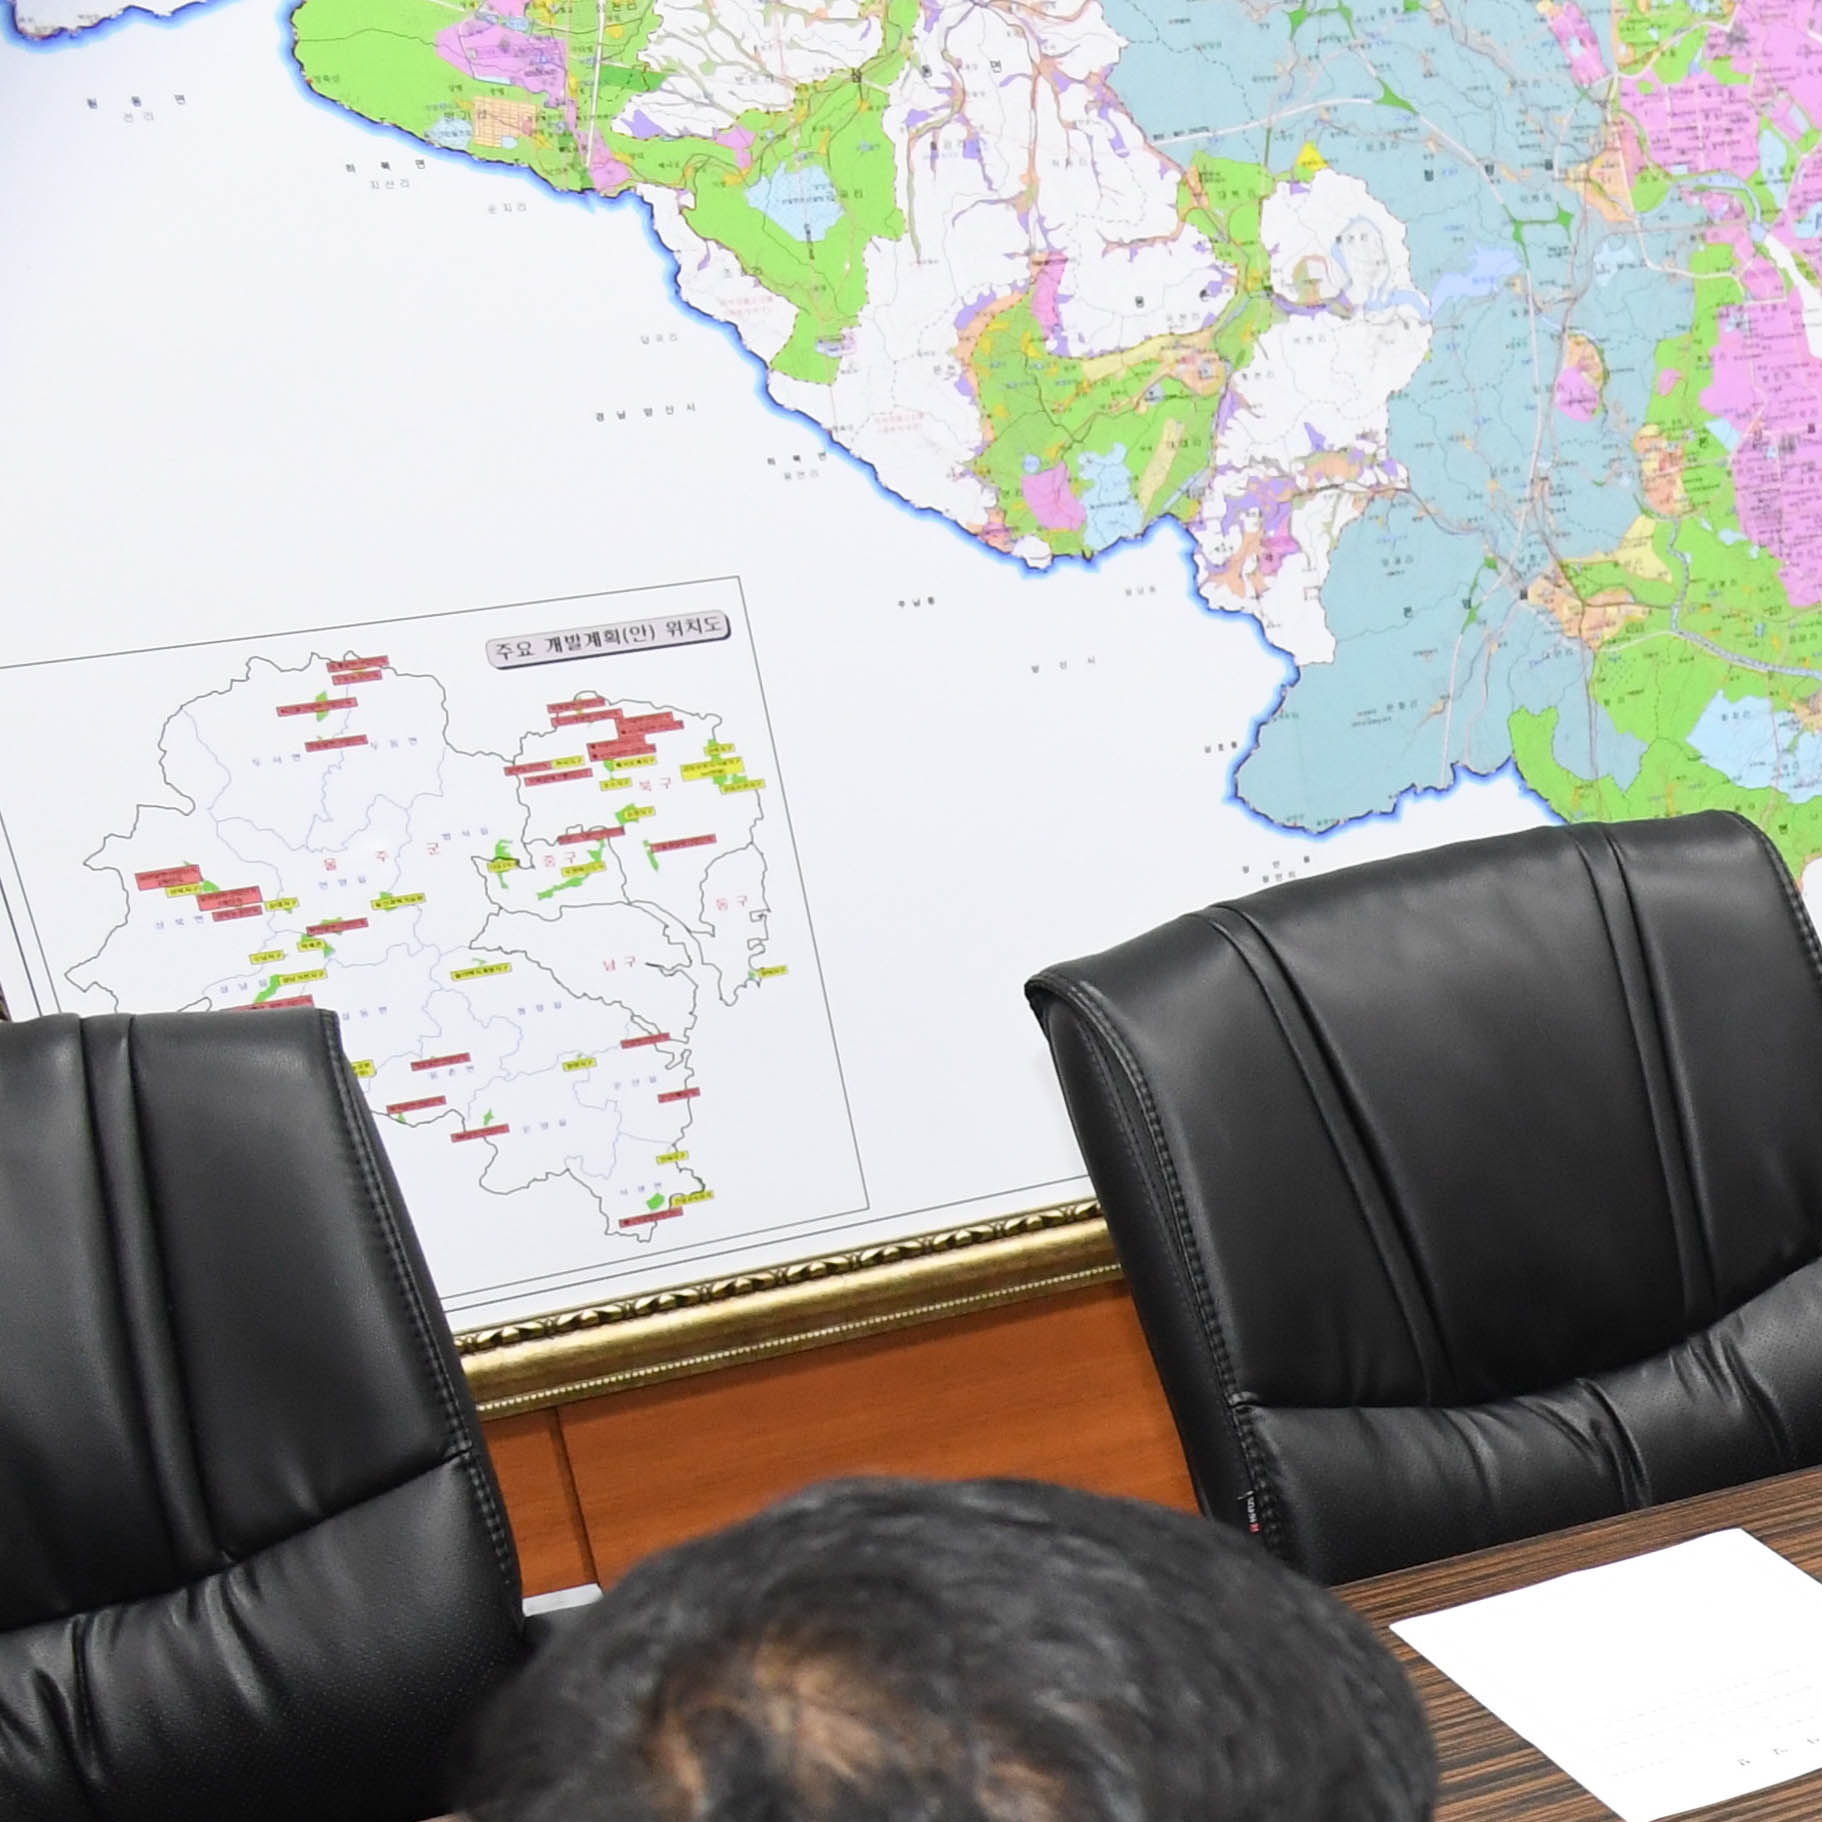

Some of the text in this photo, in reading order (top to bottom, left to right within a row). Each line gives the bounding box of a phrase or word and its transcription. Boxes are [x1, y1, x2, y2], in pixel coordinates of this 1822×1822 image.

[495, 615, 724, 660] 주요 개발계획(안) 위치도
